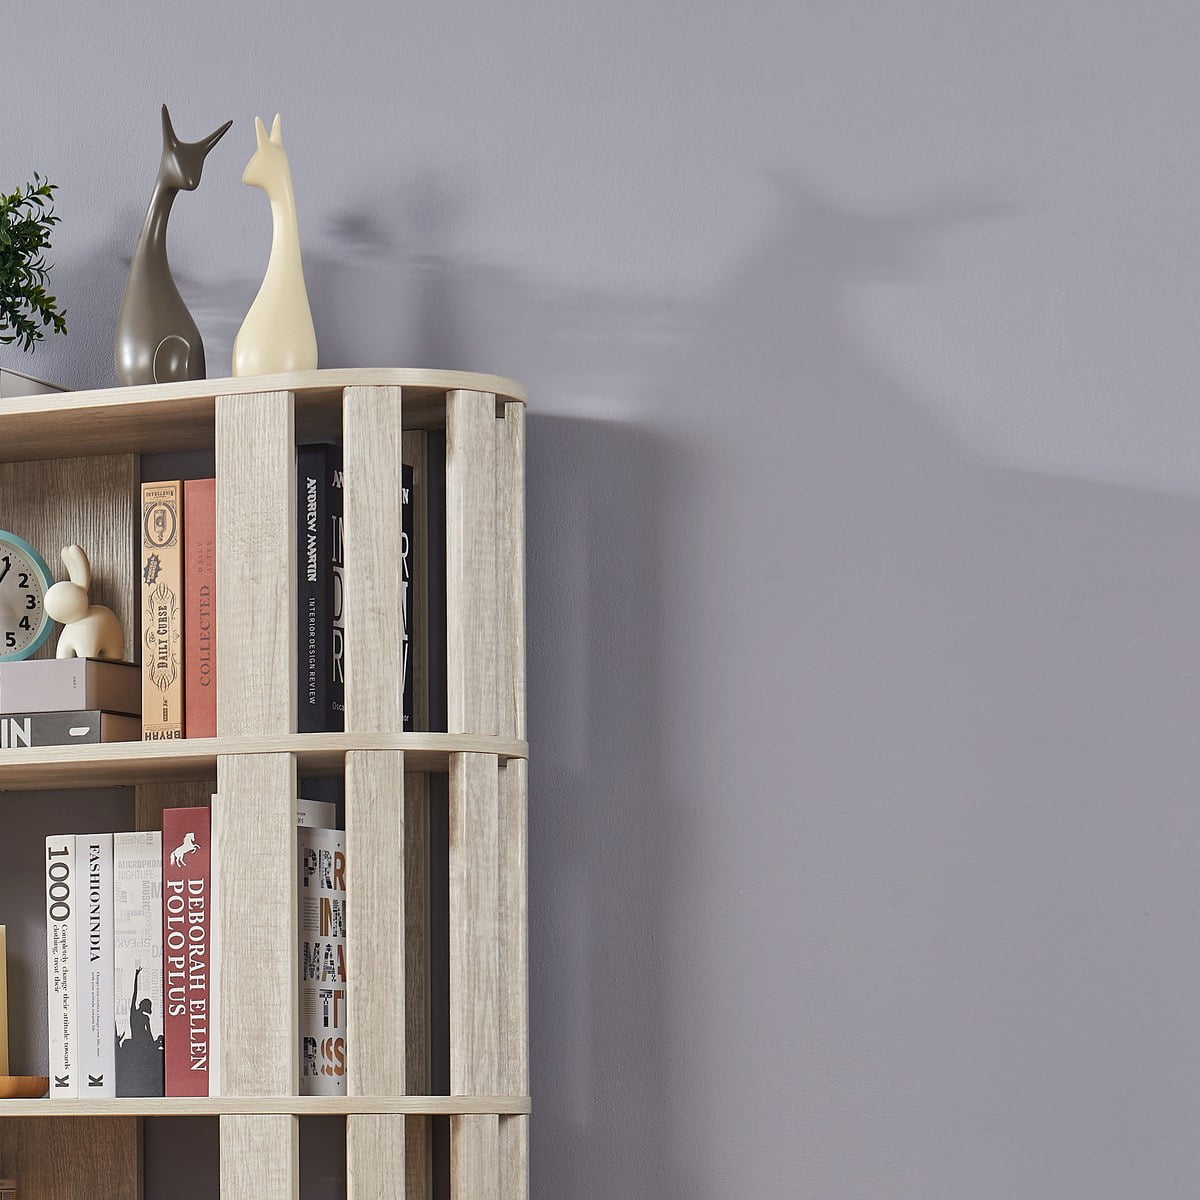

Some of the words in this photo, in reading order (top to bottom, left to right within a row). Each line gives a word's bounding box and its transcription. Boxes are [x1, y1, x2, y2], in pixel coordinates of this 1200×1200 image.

[306, 477, 317, 532] ANDREW
[306, 534, 317, 582] MARTIN
[18, 573, 29, 588] 2
[25, 594, 36, 610] 3
[157, 605, 168, 635] CURSE
[308, 597, 316, 637] INTERIOR
[5, 632, 16, 647] 5
[18, 616, 30, 631] 4
[200, 586, 211, 687] COLLECTED
[157, 639, 168, 669] DAILY
[308, 638, 316, 670] DESIGN
[308, 671, 316, 704] REVIEW
[48, 846, 71, 922] 1000
[89, 844, 101, 962] FASHIONINDIA
[167, 879, 186, 950] POLO
[188, 878, 206, 991] DEBORAH
[167, 955, 186, 1017] PLUS
[189, 998, 207, 1072] ELLEN
[55, 1074, 70, 1088] K
[88, 1074, 104, 1087] K
